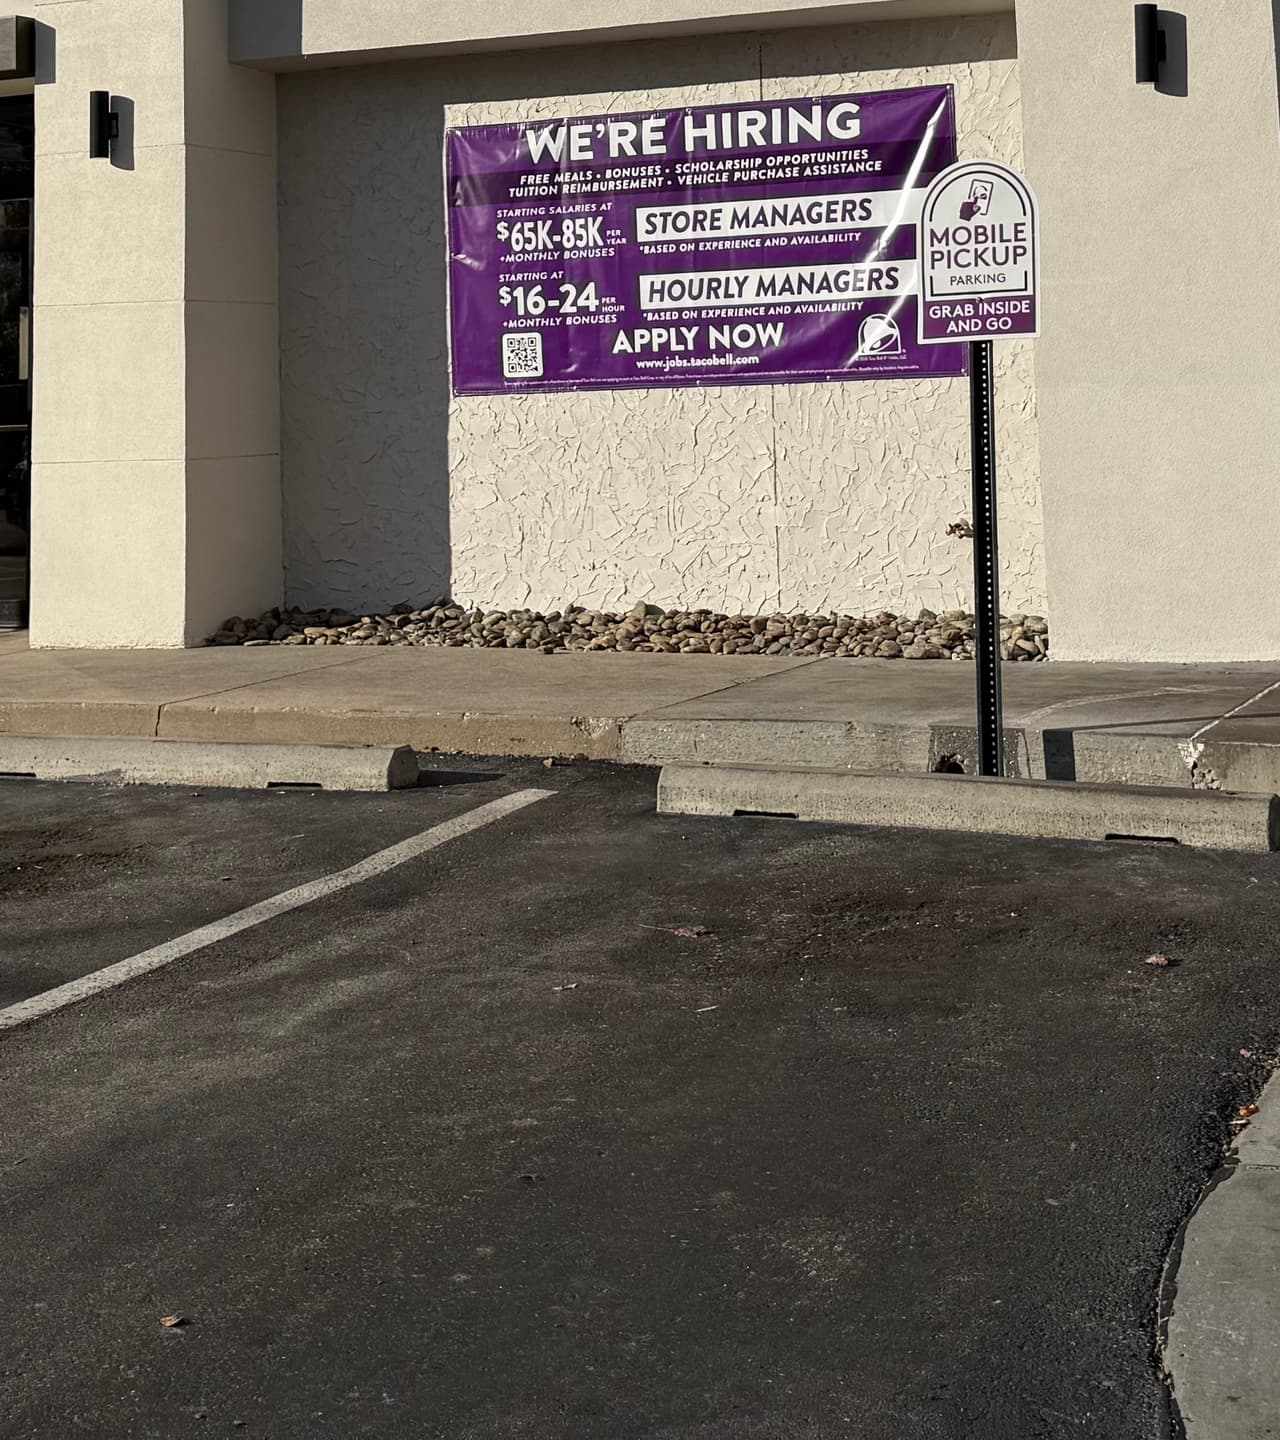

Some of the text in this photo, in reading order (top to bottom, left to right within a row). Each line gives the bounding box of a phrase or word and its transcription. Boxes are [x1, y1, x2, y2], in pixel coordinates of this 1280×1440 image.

[526, 102, 861, 164] WE'RE HIRING
[520, 149, 869, 186] FREE MEALS BONUSES SCHOLARSHIP OPPORTUNITIES
[509, 160, 883, 198] TUITION REIMBURSEMENT VEHICLE PURCHASE ASSISTANCE
[496, 202, 613, 218] STARTING SALARIES AT
[644, 197, 873, 235] STORE MANAGERS
[496, 216, 604, 252] $65K-85K
[606, 229, 621, 237] PER
[679, 242, 694, 253] ON
[698, 239, 762, 251] EXPERIENCE
[764, 237, 788, 247] AND
[790, 232, 862, 246] AVAILABILITY
[929, 222, 1027, 247] MOBILE
[563, 247, 616, 260] BONUSES
[930, 245, 1028, 270] PICKUP
[499, 270, 564, 282] STARTING AT
[648, 266, 900, 303] HOURLY MANAGERS
[950, 272, 1006, 286] PARKING
[499, 282, 599, 316] $16-24
[602, 305, 625, 313] HOUR
[682, 309, 697, 320] ON
[701, 306, 766, 319] EXPERIENCE
[768, 305, 792, 315] AND
[795, 301, 864, 314] AVAILABILITY
[929, 300, 1030, 319] GRAB INSIDE
[565, 314, 617, 326] BONUSES
[946, 316, 1012, 333] AND GO
[611, 321, 784, 355] APPLY NOW
[636, 354, 760, 372] www.jobs.tacobell.com
